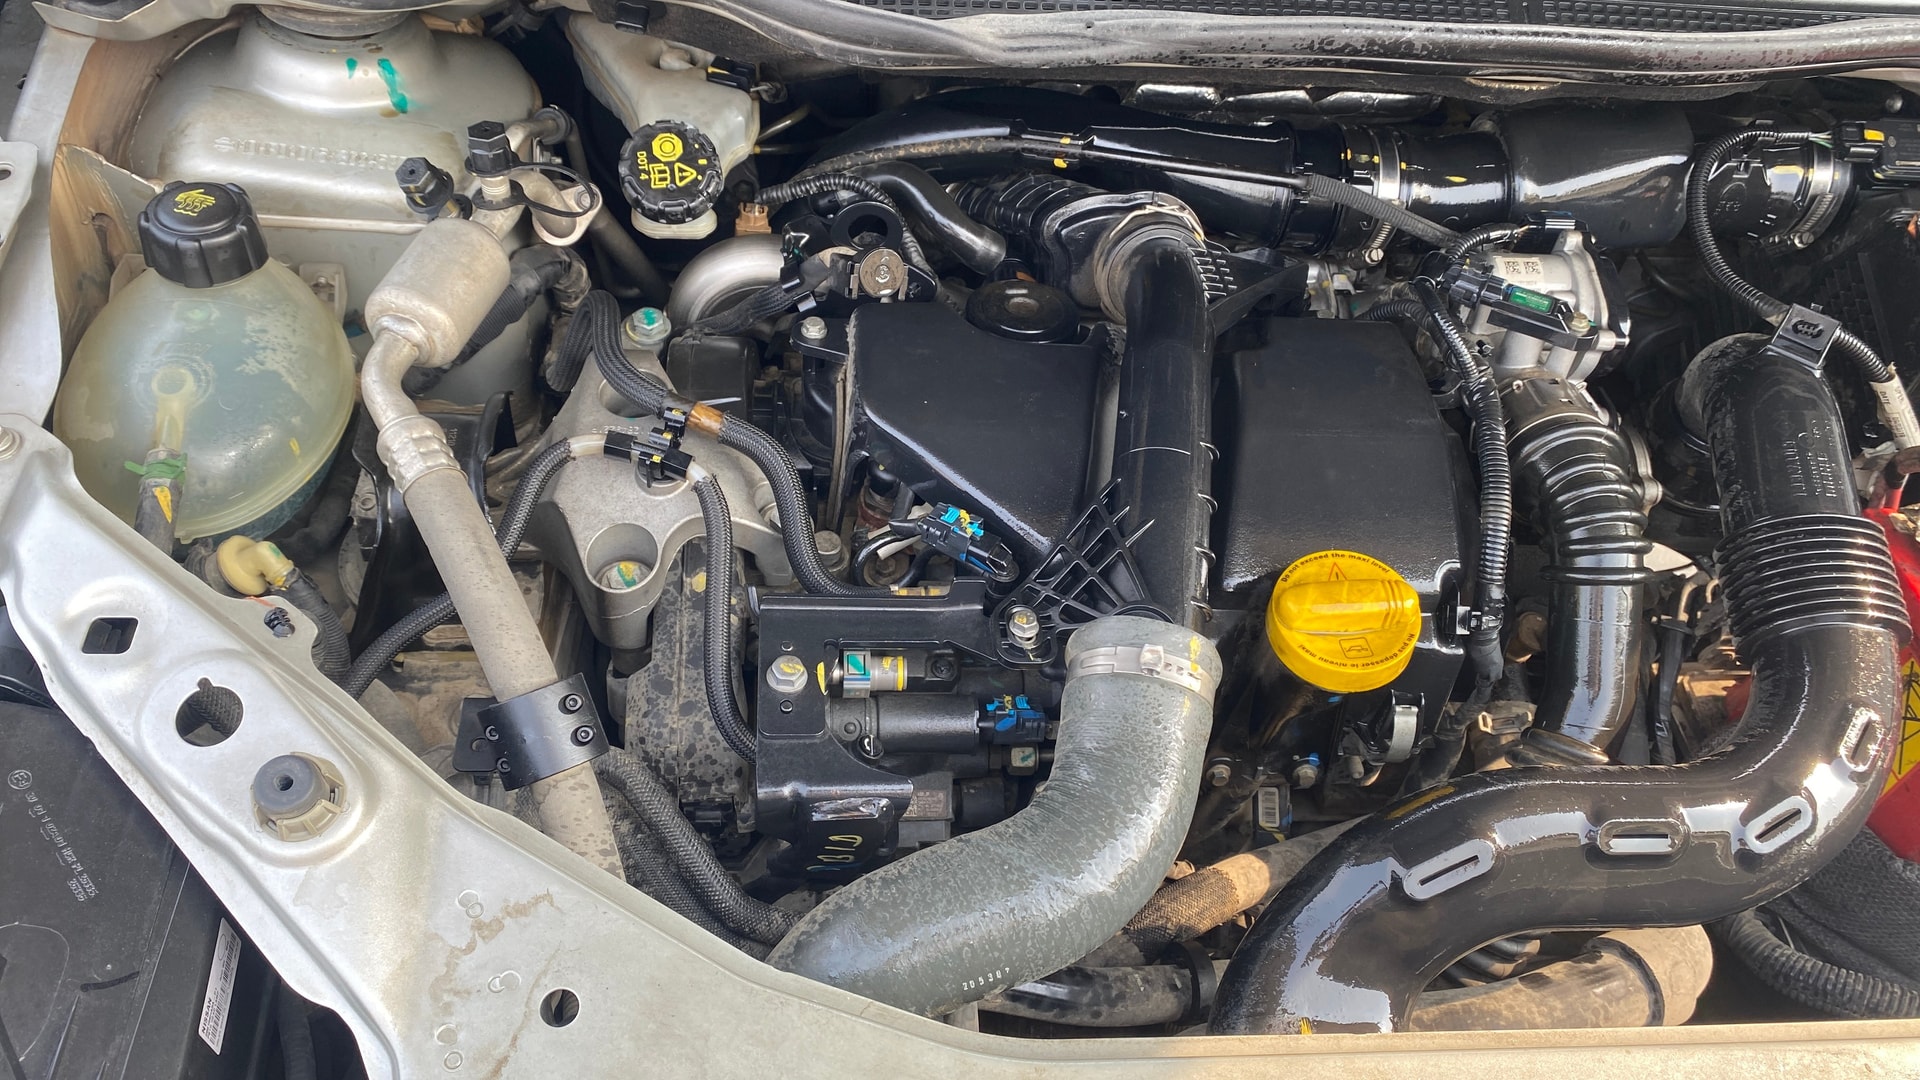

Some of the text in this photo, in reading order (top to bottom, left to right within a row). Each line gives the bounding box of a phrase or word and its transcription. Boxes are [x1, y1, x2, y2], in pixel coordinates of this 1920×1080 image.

[636, 150, 649, 181] DOT 4
[1281, 574, 1290, 583] Do
[1289, 565, 1300, 575] not
[1300, 553, 1329, 566] exceed
[1348, 554, 1370, 564] maxi
[1371, 561, 1391, 573] level
[1406, 633, 1415, 642] Ne
[1297, 643, 1317, 658] maxi
[1397, 642, 1408, 654] pas
[1317, 655, 1348, 668] niveau
[201, 997, 213, 1034] NISSAN
